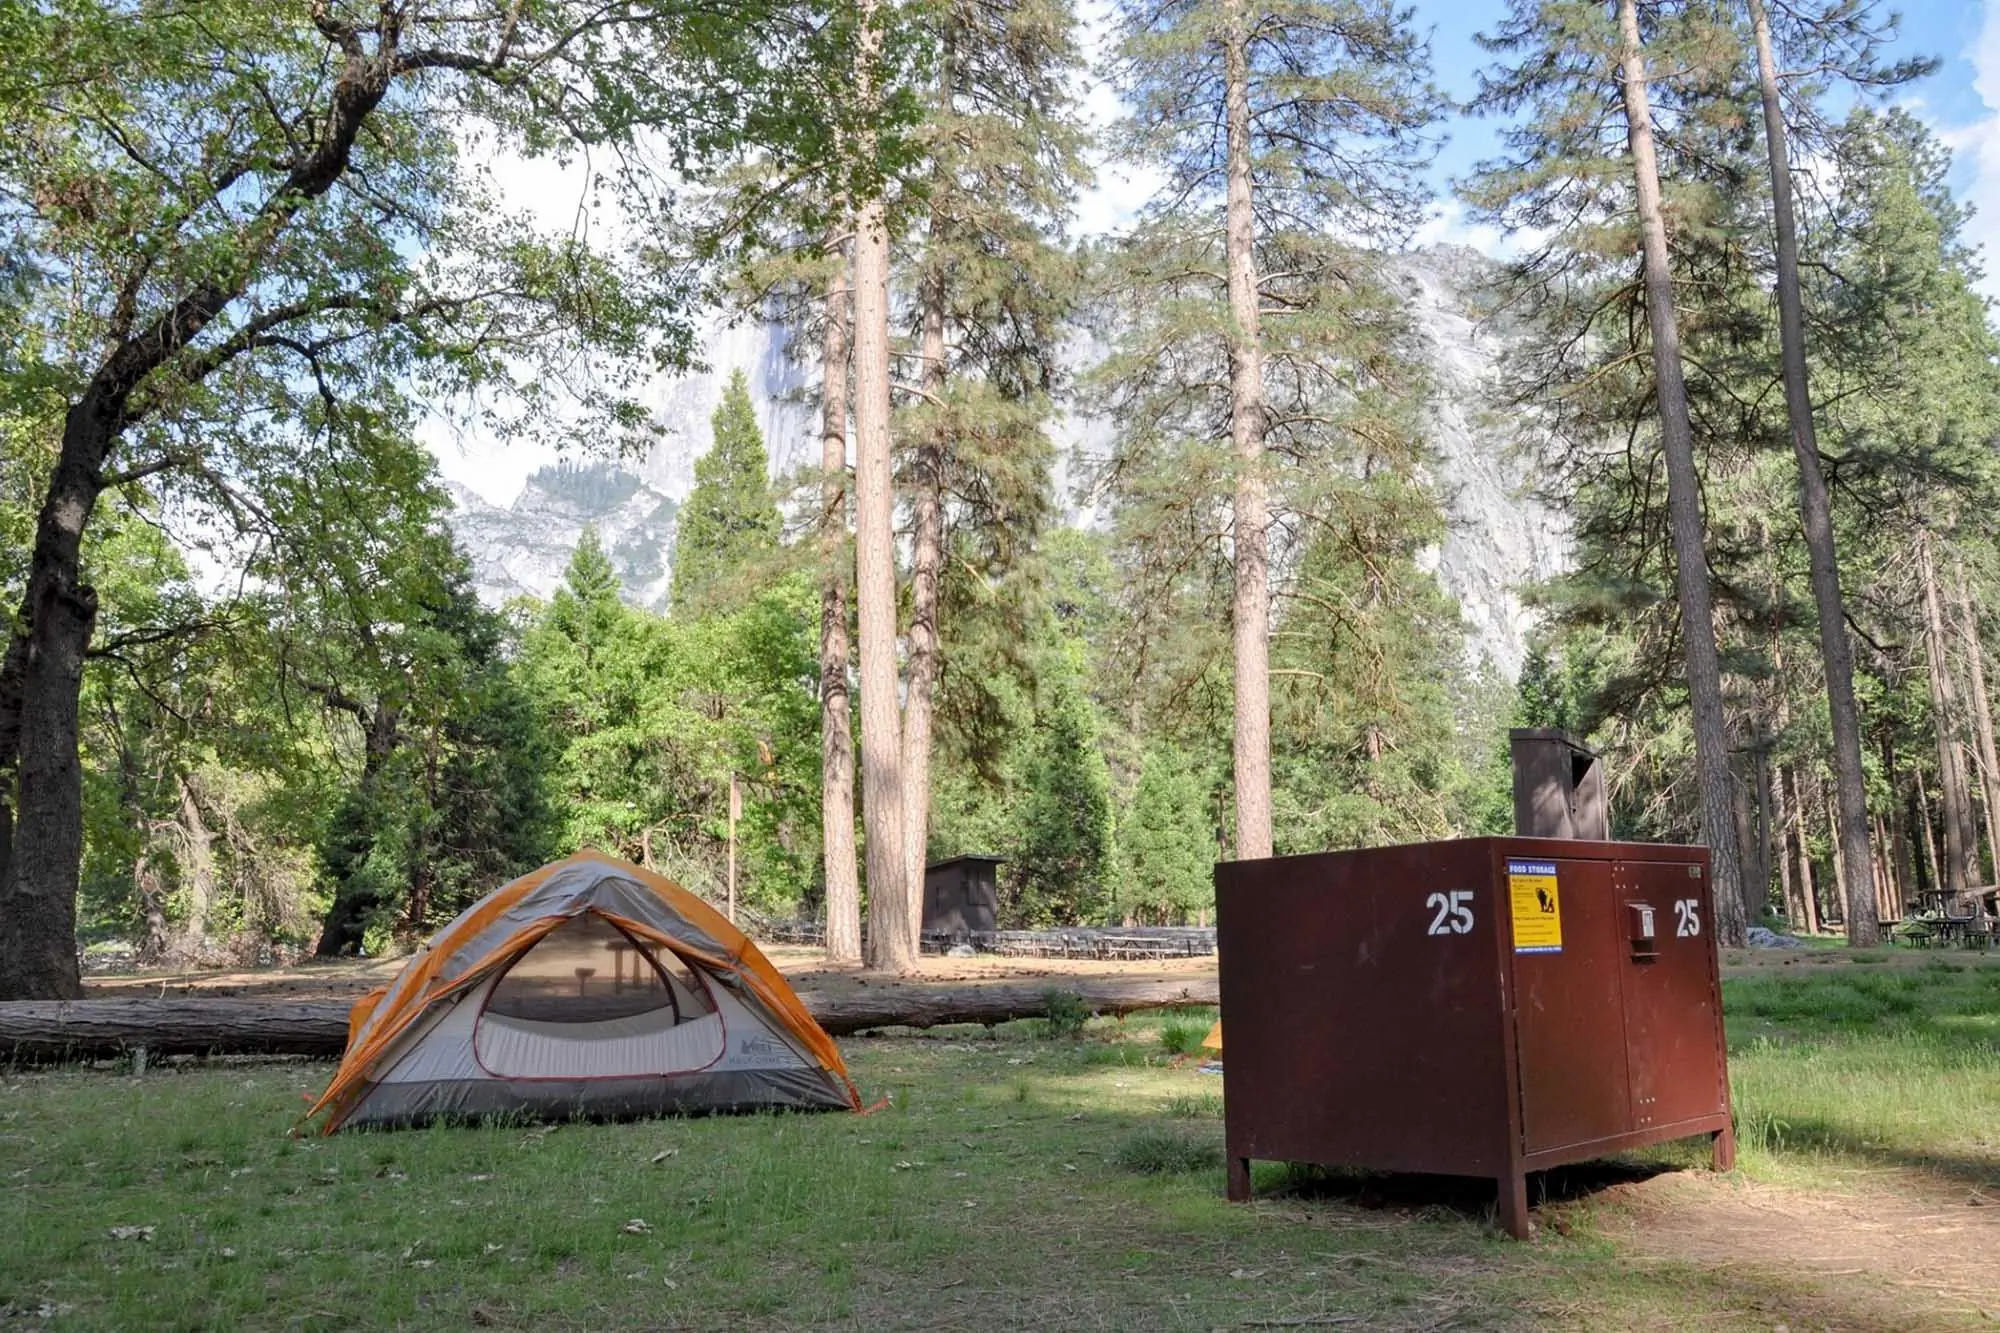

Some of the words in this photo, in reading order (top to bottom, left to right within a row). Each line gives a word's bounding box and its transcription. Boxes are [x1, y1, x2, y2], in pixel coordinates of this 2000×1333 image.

[1509, 865, 1527, 873] FOOD
[1528, 865, 1556, 874] STORAGE
[1426, 890, 1474, 935] 25
[1674, 899, 1700, 937] 25
